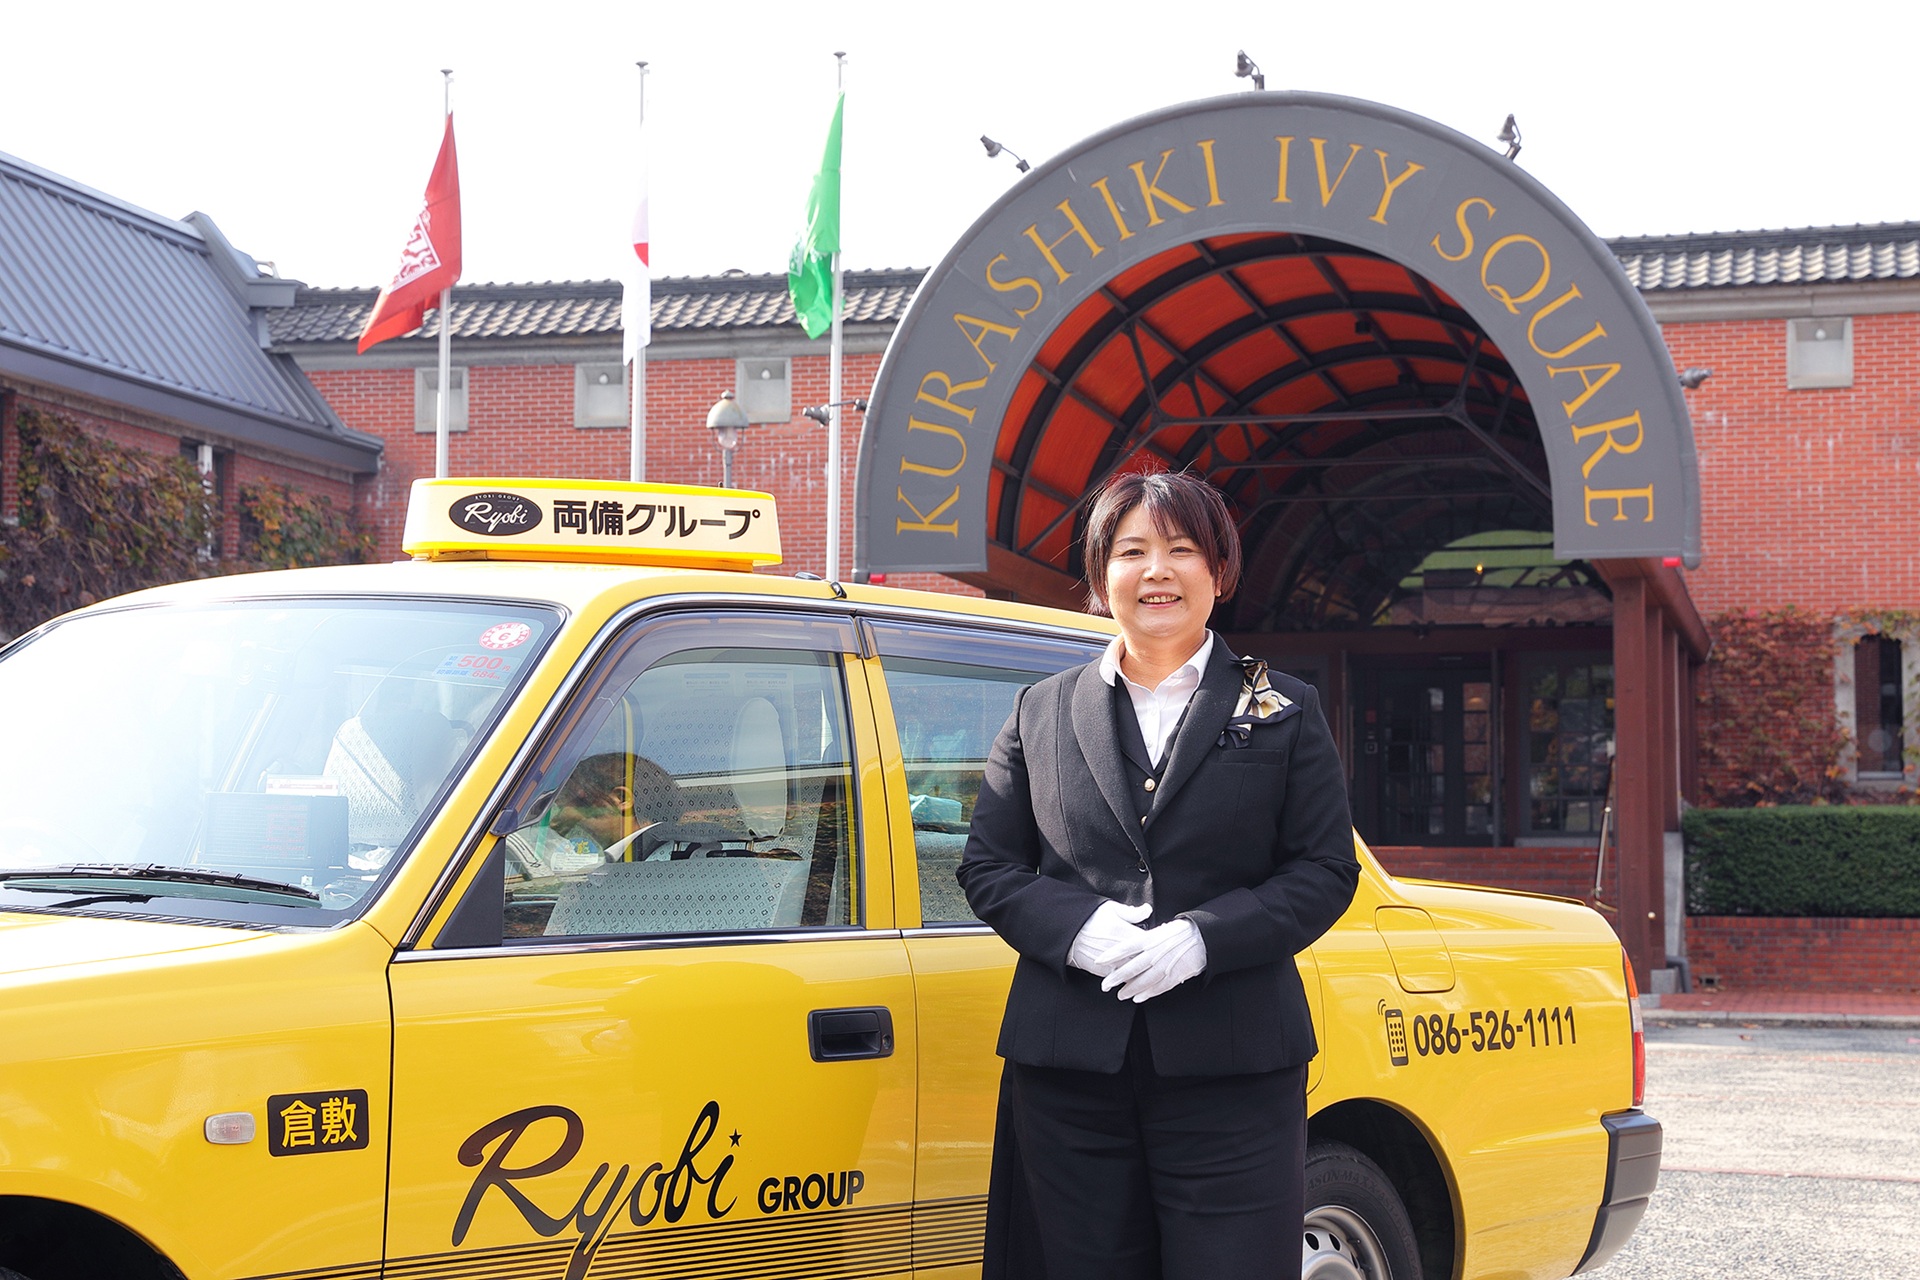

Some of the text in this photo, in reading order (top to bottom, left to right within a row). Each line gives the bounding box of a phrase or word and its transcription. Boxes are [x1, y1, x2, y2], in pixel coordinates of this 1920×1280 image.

[896, 136, 1654, 537] KURASHIKI IVY SQUARE
[464, 502, 528, 533] Ryobi
[553, 499, 761, 540] 両備グループ
[1413, 1006, 1576, 1056] 086-526-1111
[280, 1096, 358, 1148] 倉敷
[451, 1101, 865, 1280] Ryobi GROUP
[1305, 1169, 1339, 1193] ASON
